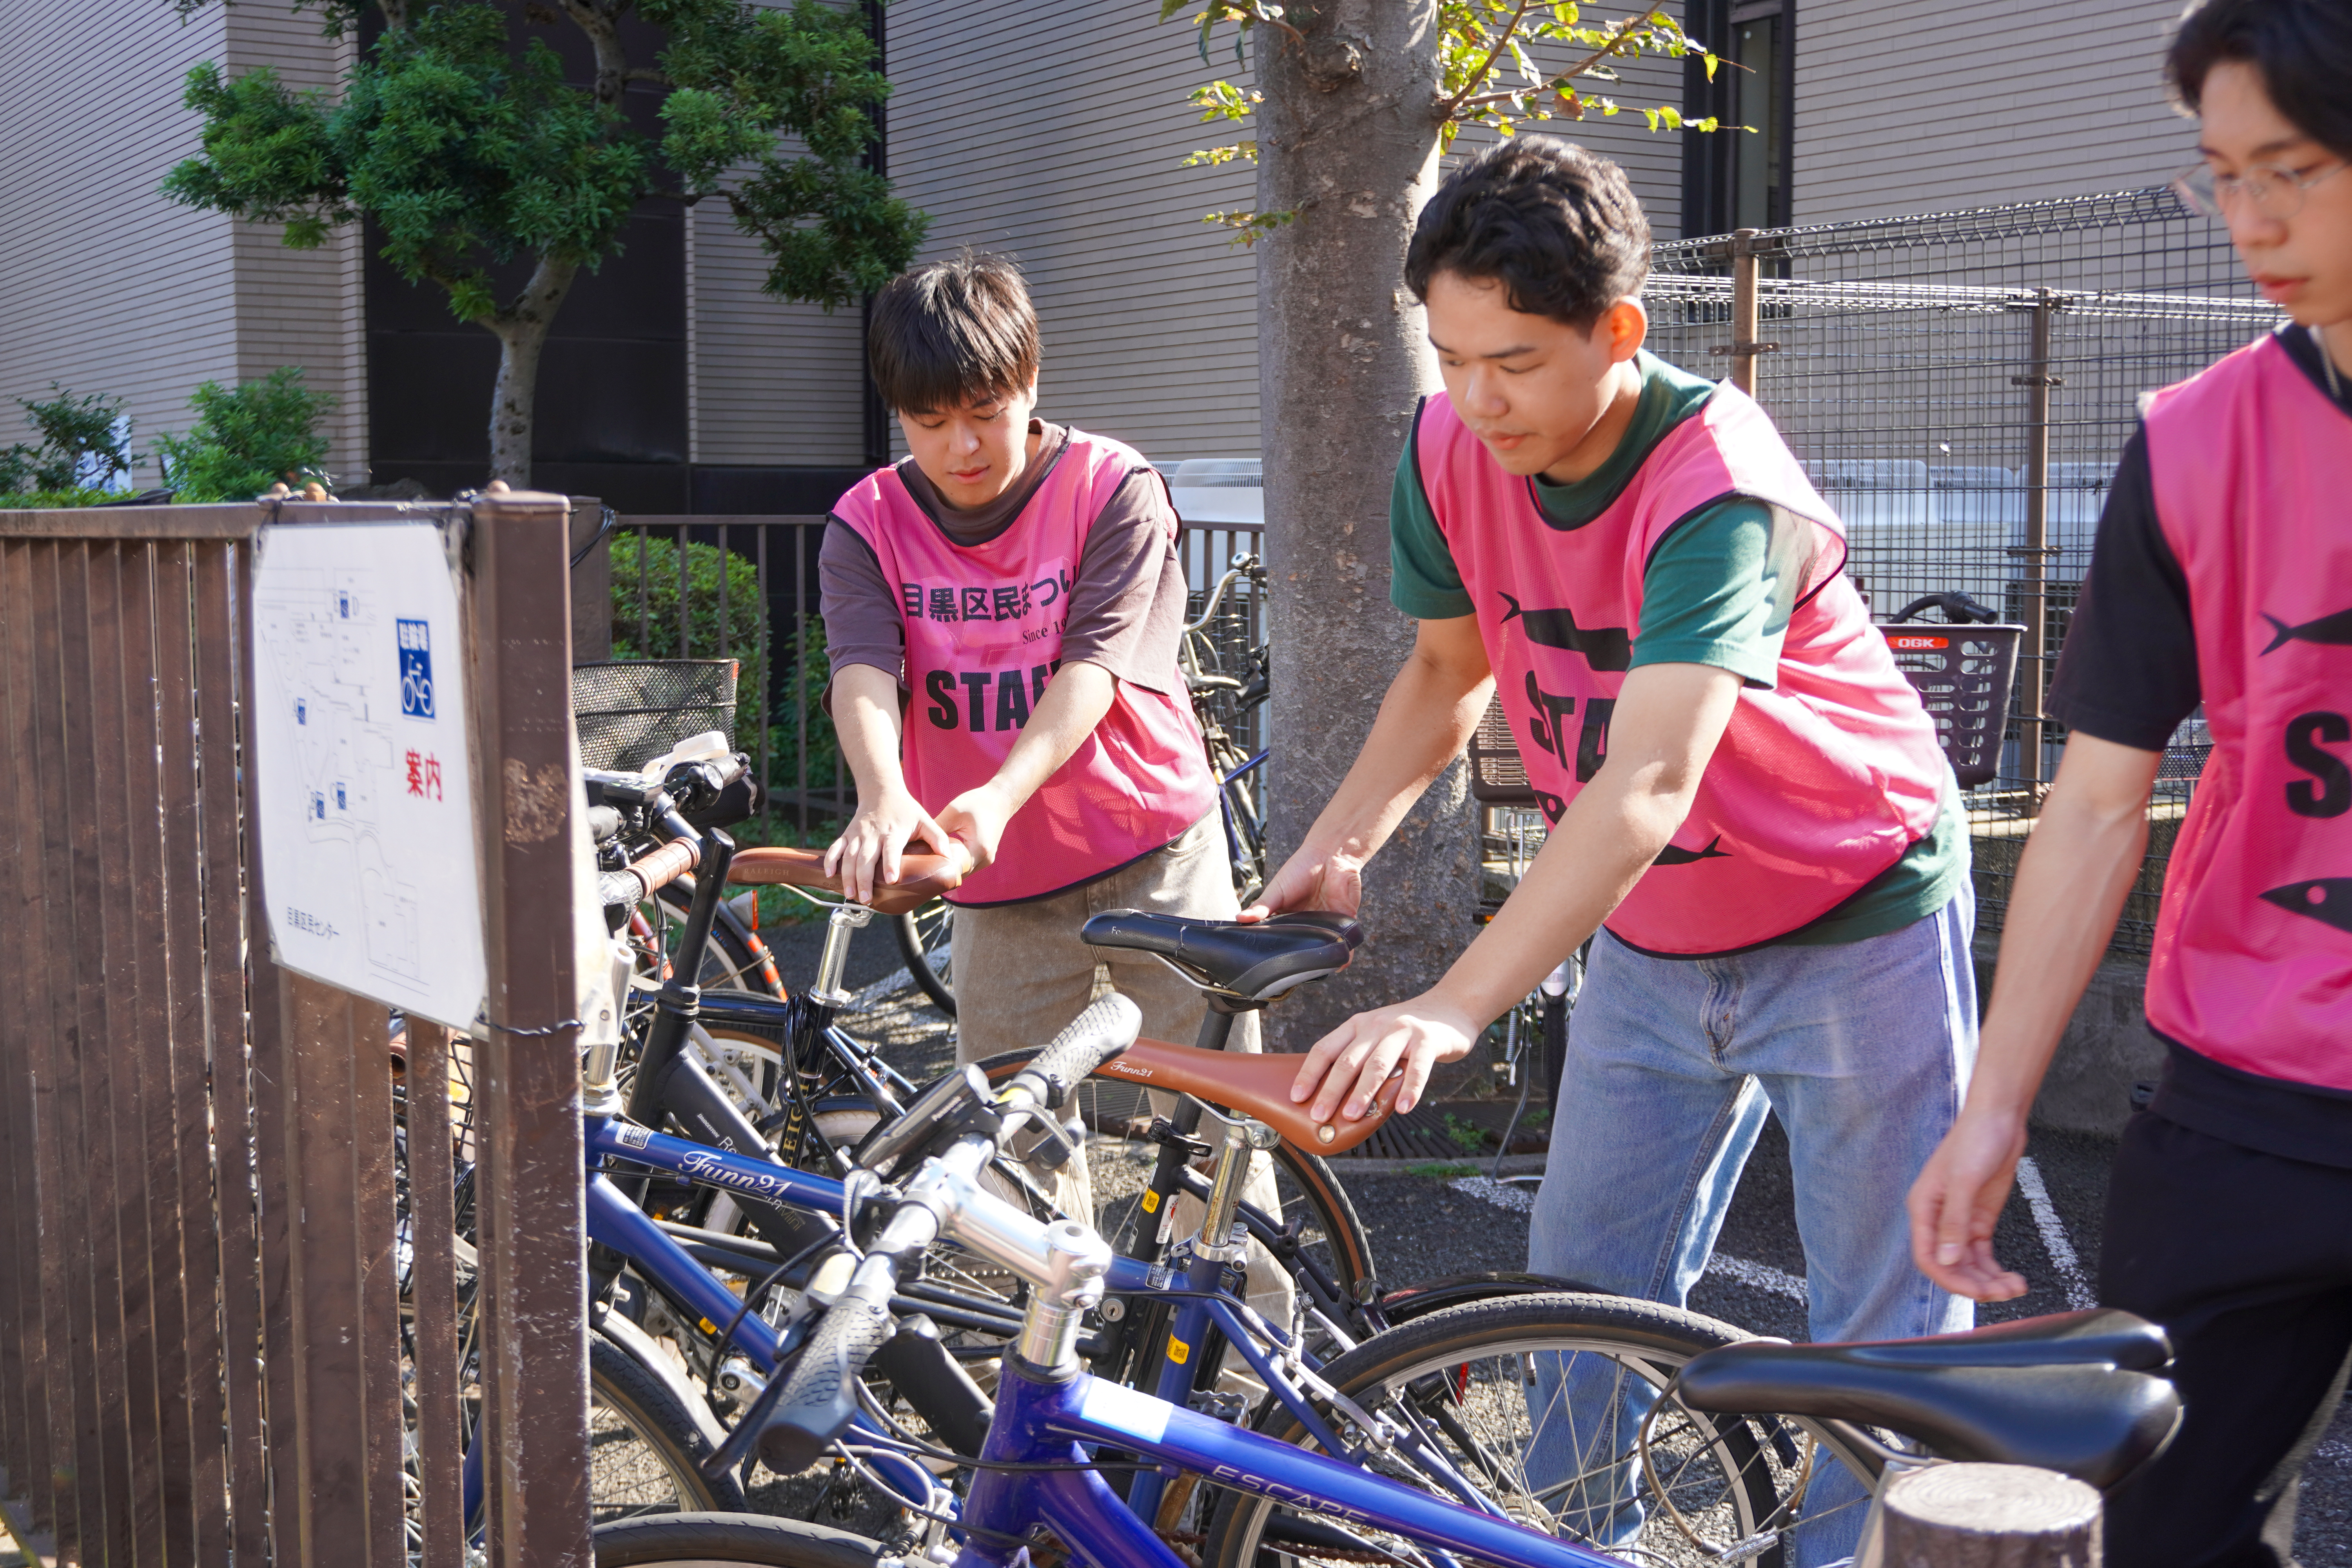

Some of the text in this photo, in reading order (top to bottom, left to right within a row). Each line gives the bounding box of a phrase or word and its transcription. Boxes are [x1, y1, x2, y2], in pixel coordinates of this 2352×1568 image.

[1022, 628, 1049, 645] Since
[1898, 638, 1935, 648] OGK
[926, 658, 1061, 732] STAF
[744, 867, 789, 877] RALEIGH
[1110, 1061, 1153, 1078] Funn21
[697, 1113, 720, 1138] BRIDGESTONE
[678, 1151, 793, 1197] Funn21
[1212, 1465, 1370, 1522] ESCAPE
